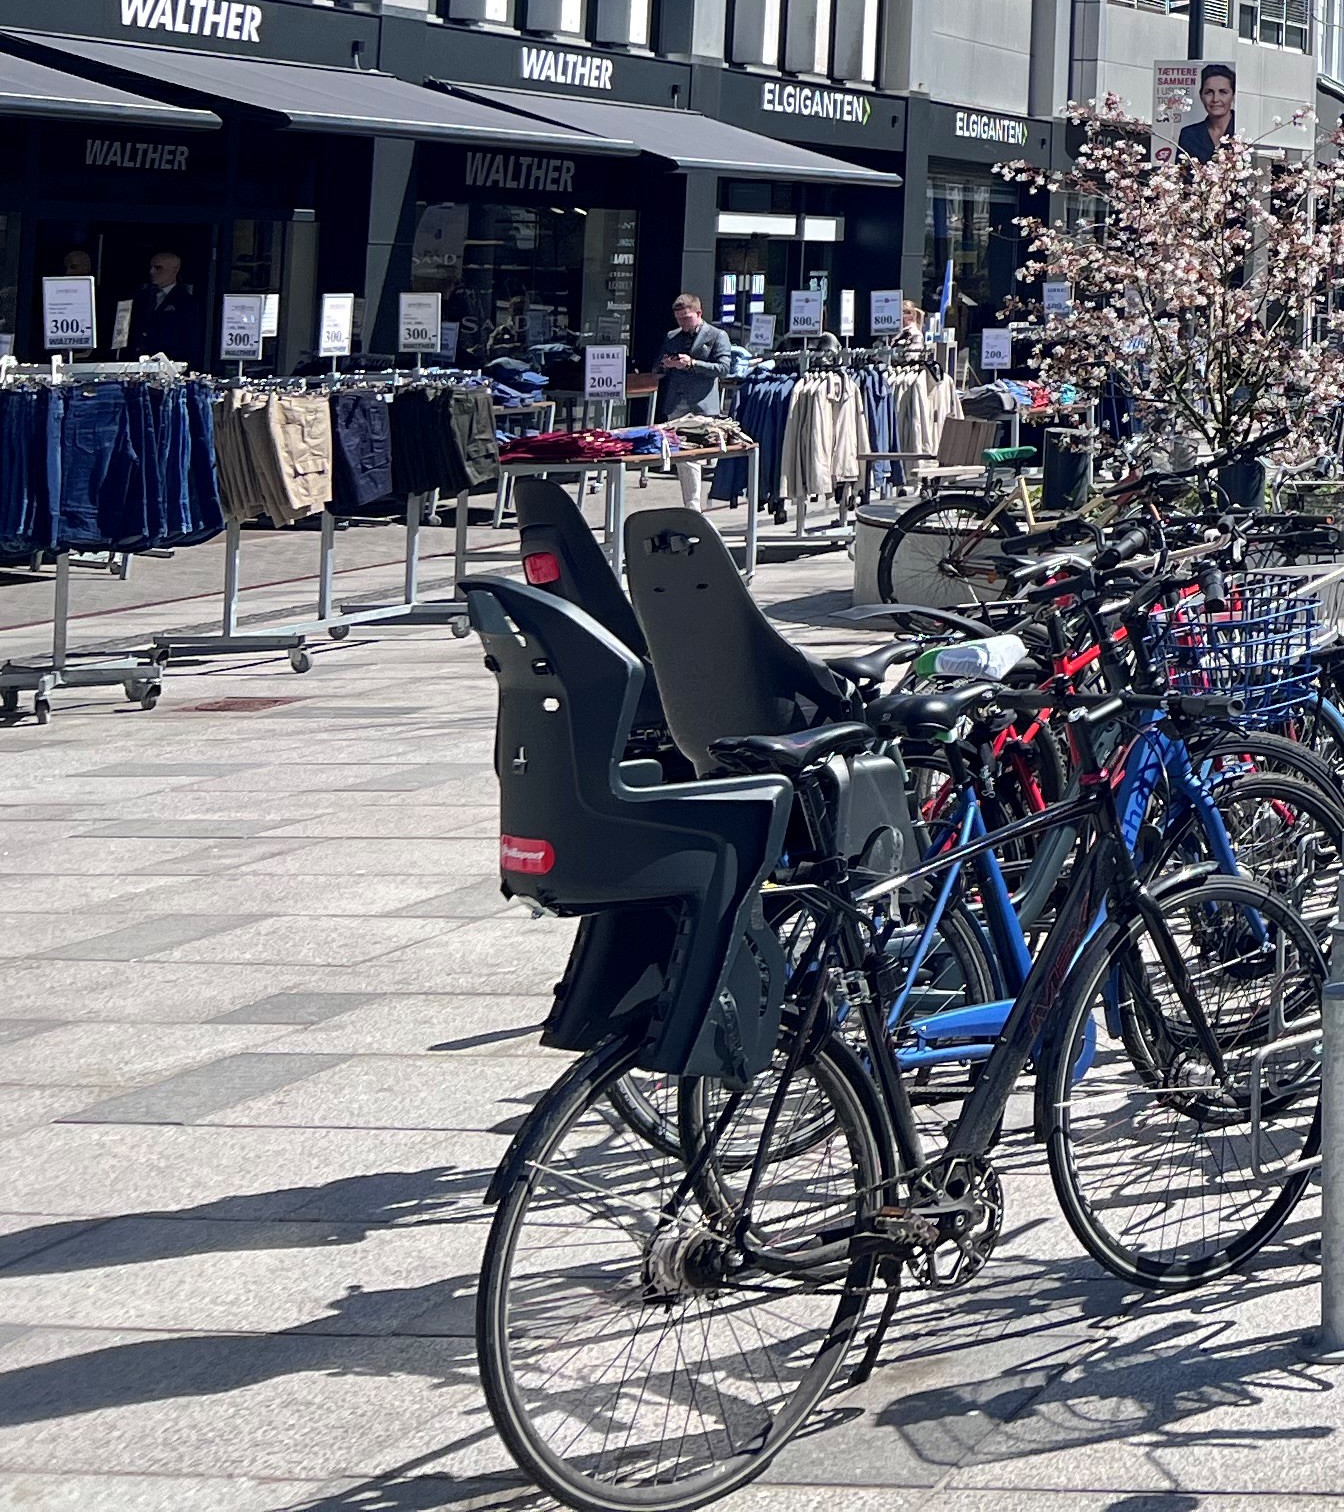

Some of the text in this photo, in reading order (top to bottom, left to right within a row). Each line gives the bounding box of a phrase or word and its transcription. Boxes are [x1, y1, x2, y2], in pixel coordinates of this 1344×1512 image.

[520, 46, 613, 90] WALTHER
[1157, 67, 1197, 77] TÆTTERE
[1157, 77, 1196, 86] SAMMEN
[761, 82, 865, 125] ELGIGANTEN
[955, 111, 1023, 145] ELGIGANTEN
[85, 139, 189, 171] WALTHER
[464, 152, 575, 193] WALTHER
